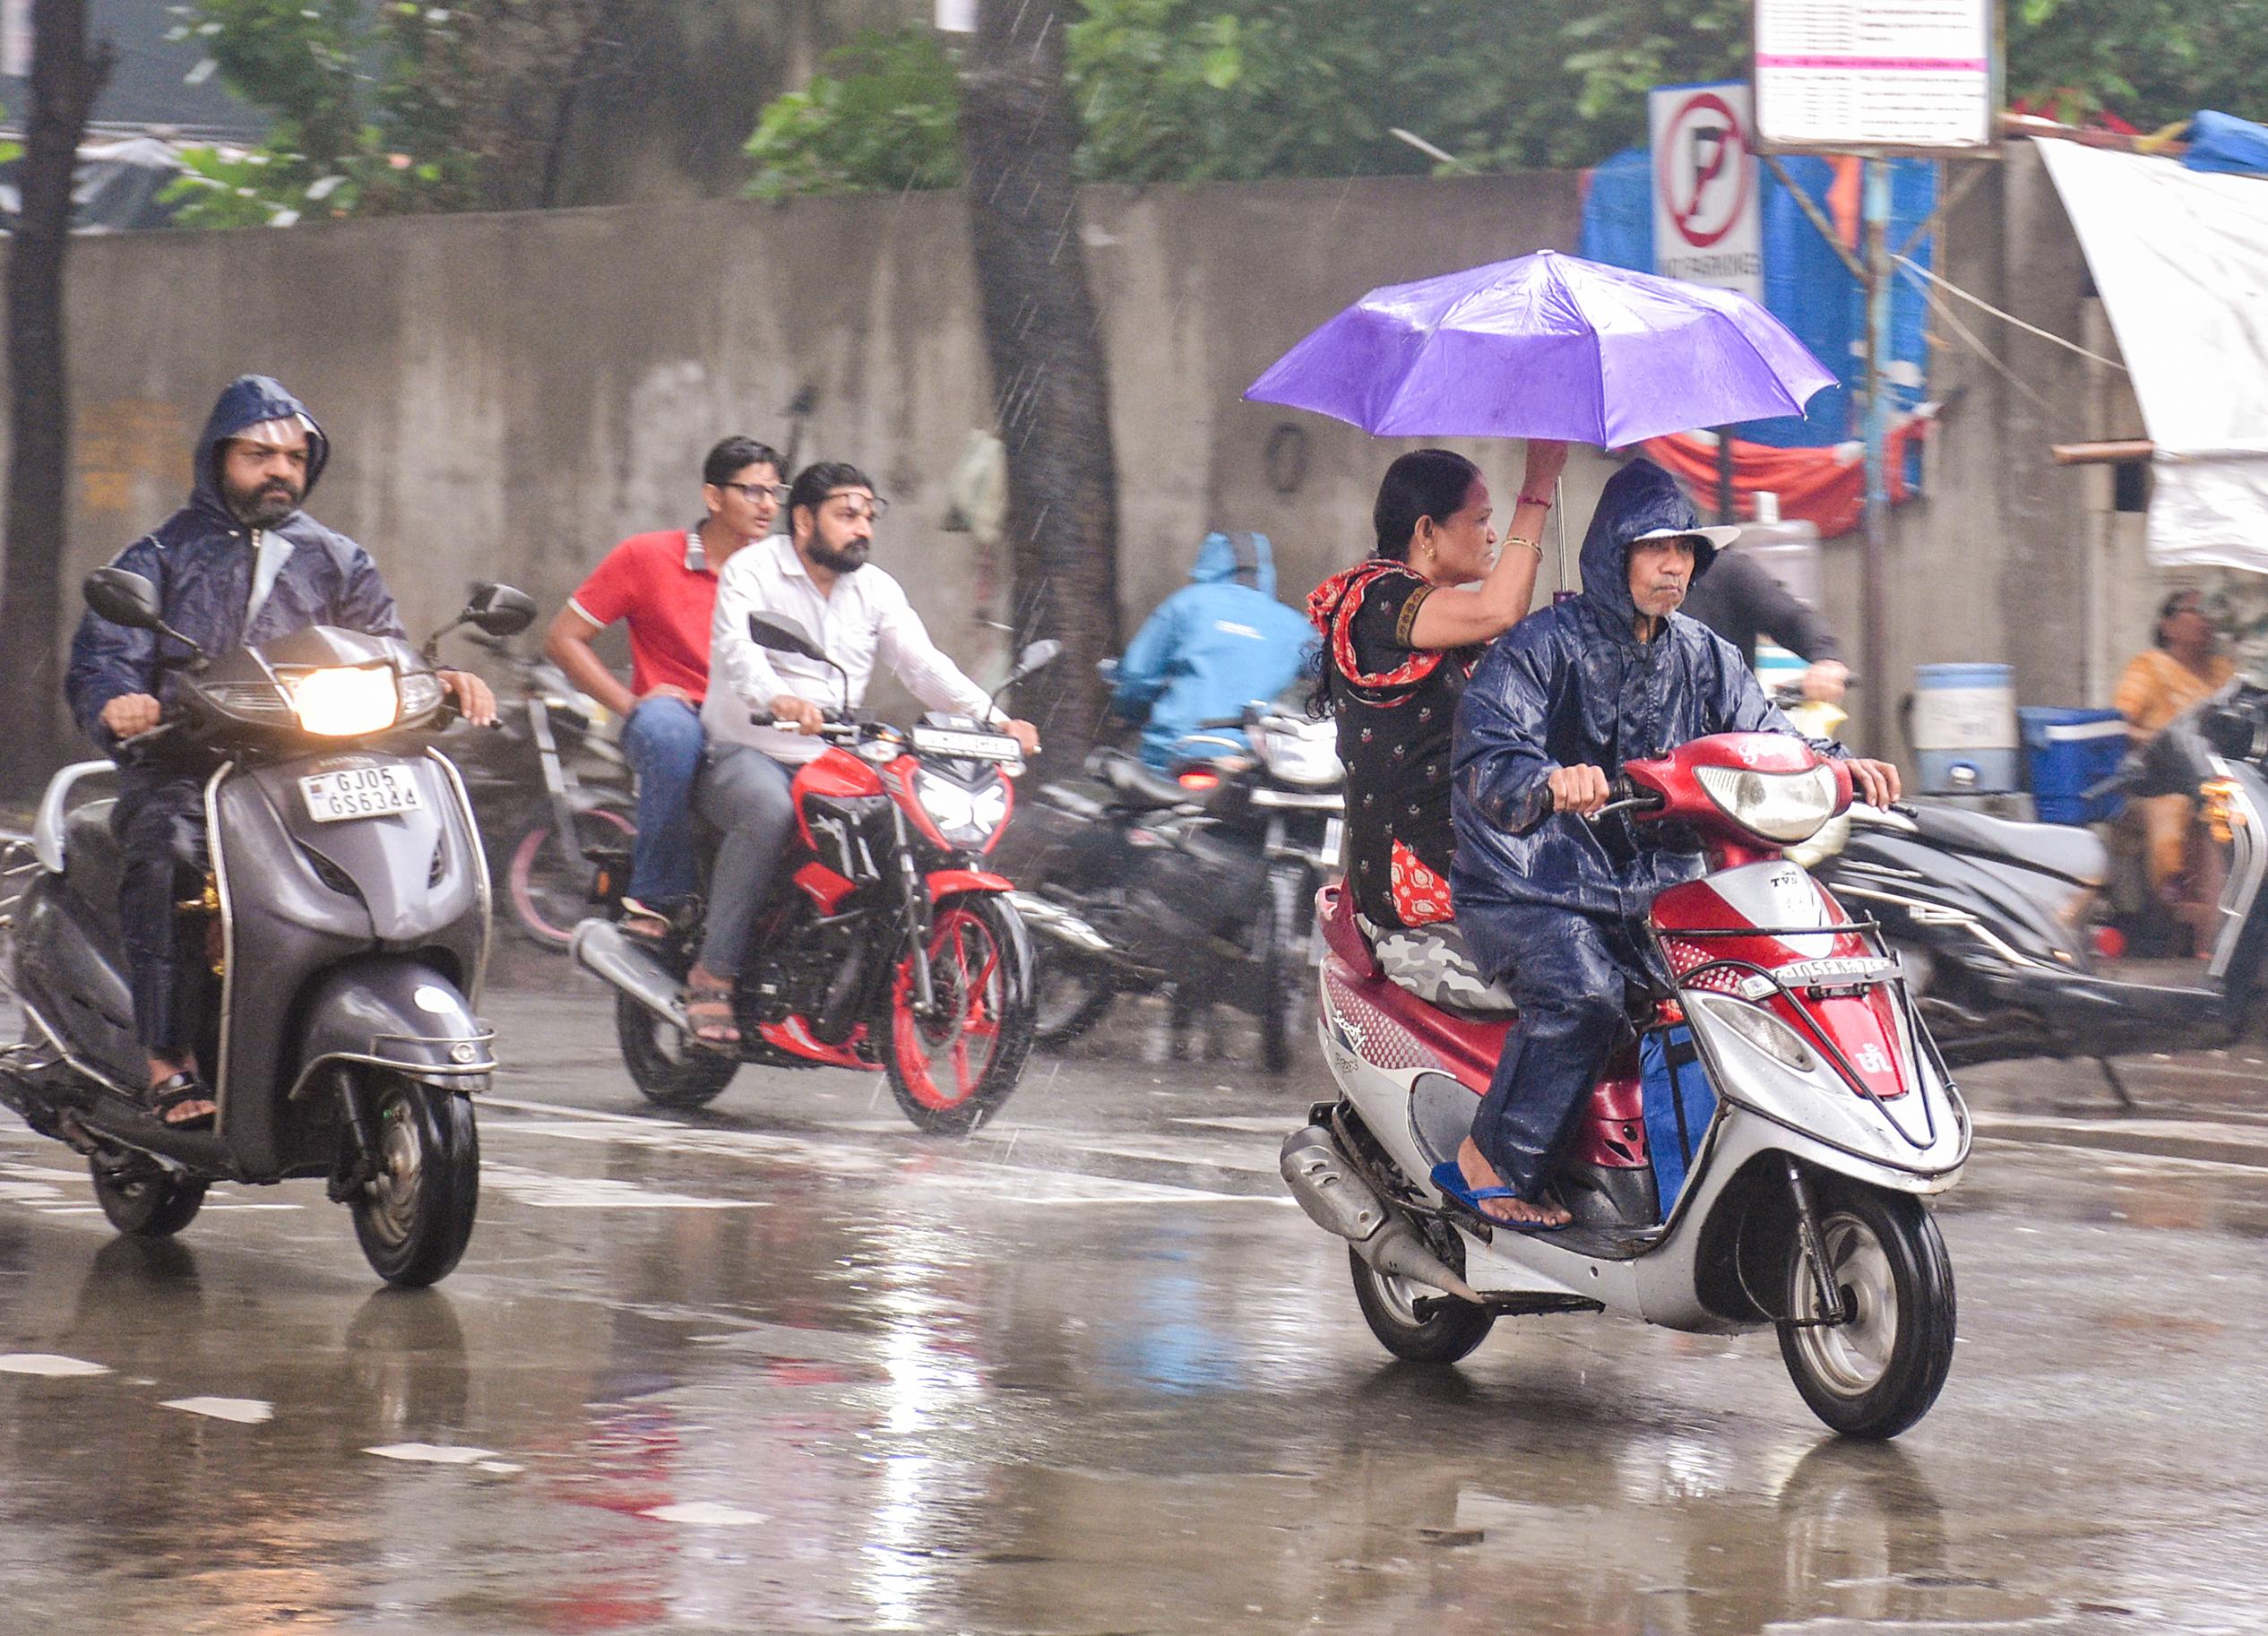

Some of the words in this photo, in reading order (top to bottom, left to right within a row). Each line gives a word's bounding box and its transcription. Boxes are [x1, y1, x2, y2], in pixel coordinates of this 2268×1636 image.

[336, 768, 394, 791] GJ05
[329, 788, 417, 814] GS6344
[1332, 1010, 1367, 1051] Scooty
